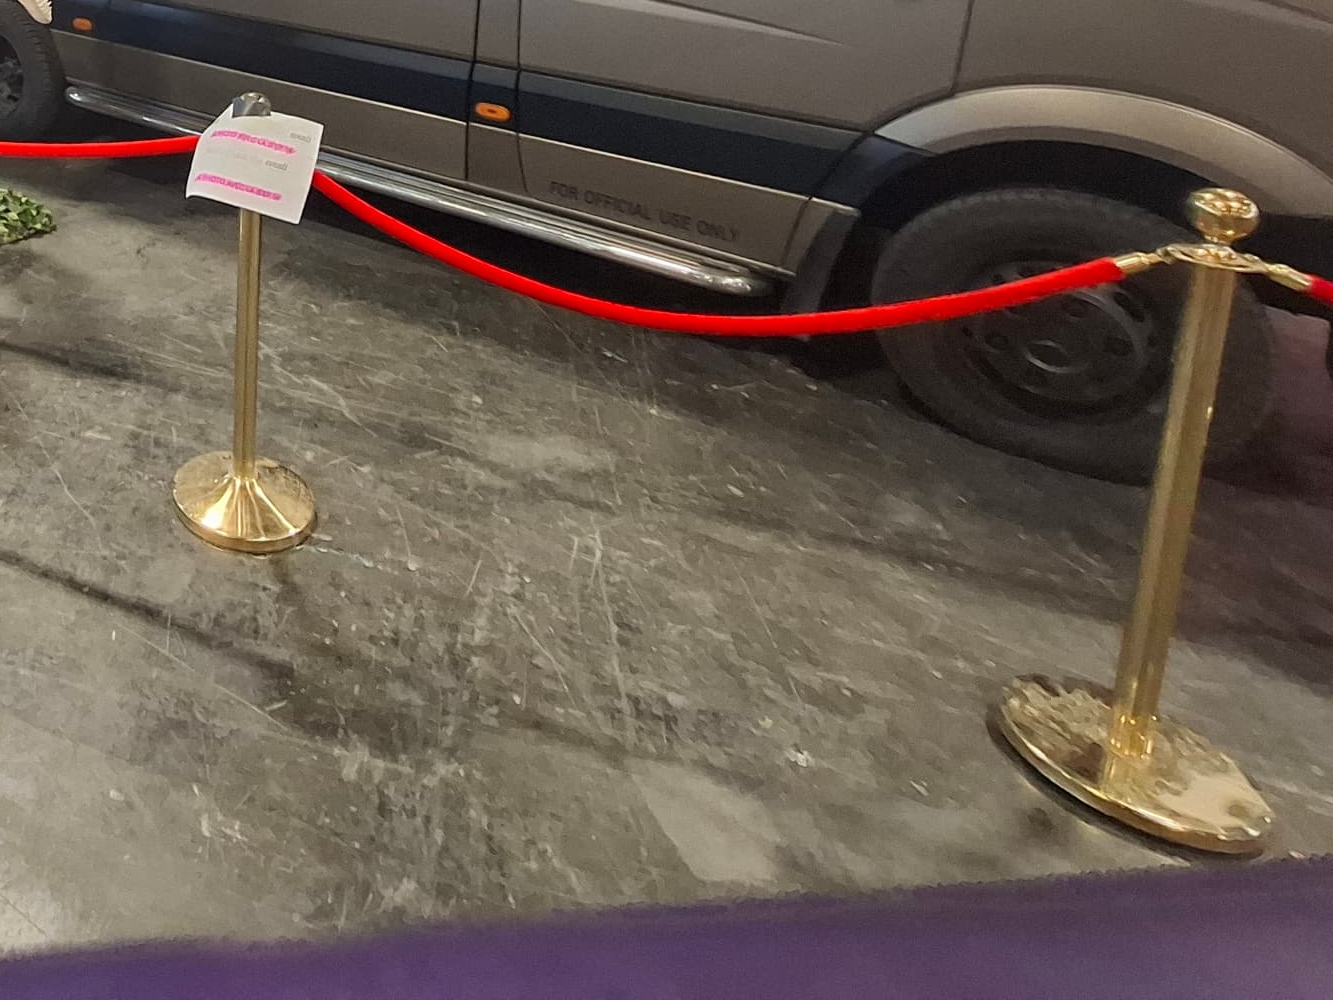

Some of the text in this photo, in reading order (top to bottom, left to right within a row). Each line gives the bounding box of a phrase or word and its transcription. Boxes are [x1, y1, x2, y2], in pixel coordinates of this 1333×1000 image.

[549, 181, 740, 242] FOR OFFICIAL USE ONLY
